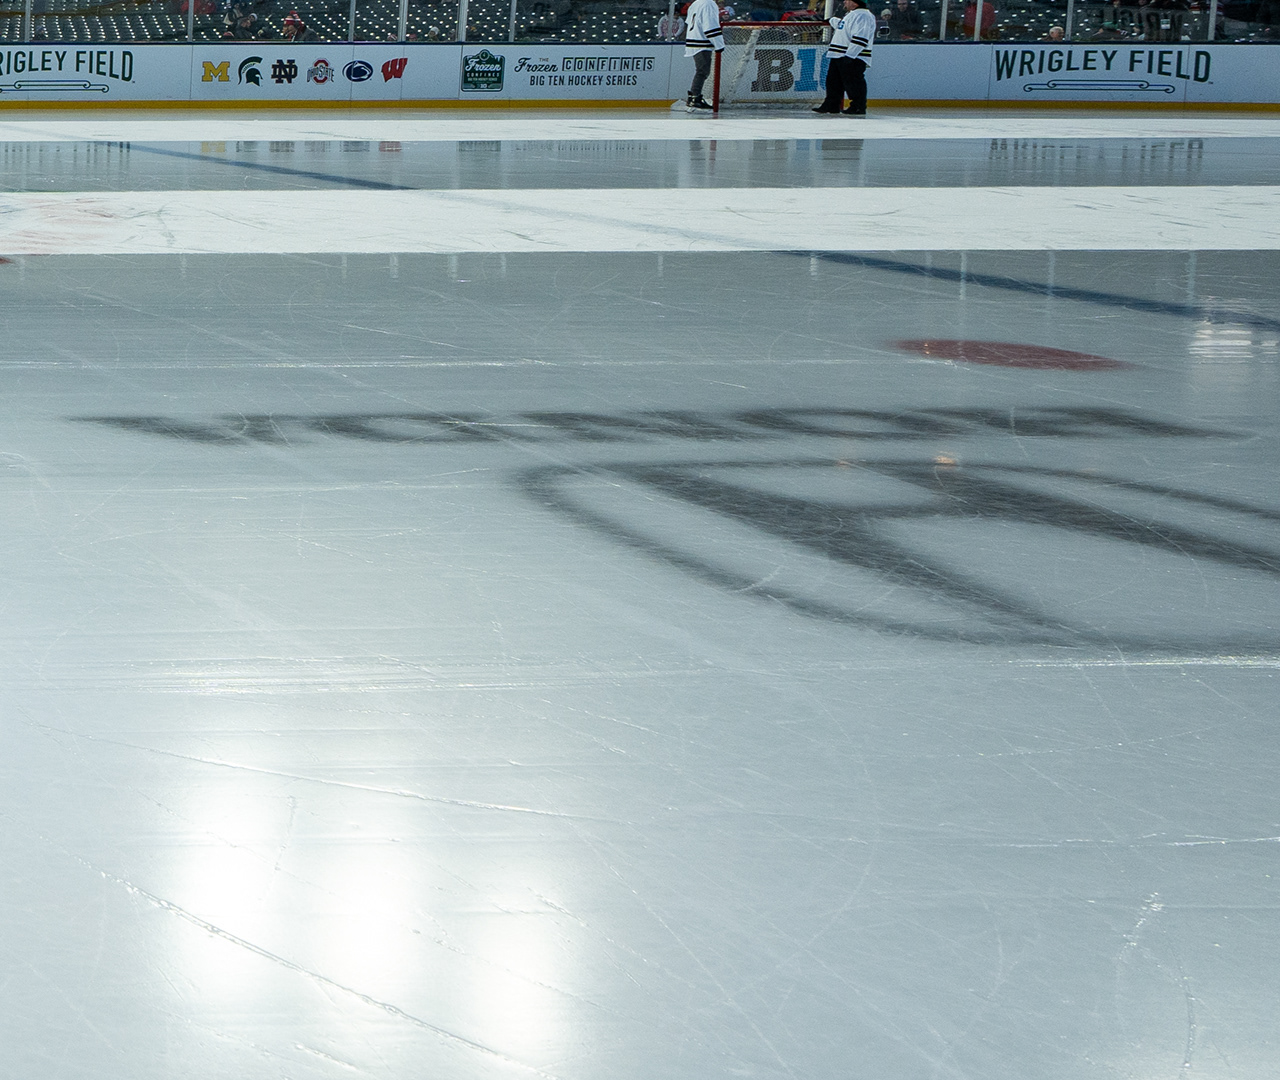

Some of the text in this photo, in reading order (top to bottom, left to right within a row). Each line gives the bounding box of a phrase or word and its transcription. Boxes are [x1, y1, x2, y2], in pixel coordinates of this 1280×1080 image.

[74, 50, 134, 83] FIELD
[201, 61, 231, 82] M
[465, 58, 502, 72] Frozen
[514, 57, 654, 73] Frozen CONFINES
[994, 49, 1212, 83] WRIGLEY FIELD
[530, 74, 637, 86] BIG TEN HOCKEY SERIES
[68, 407, 1246, 447] HONDA
